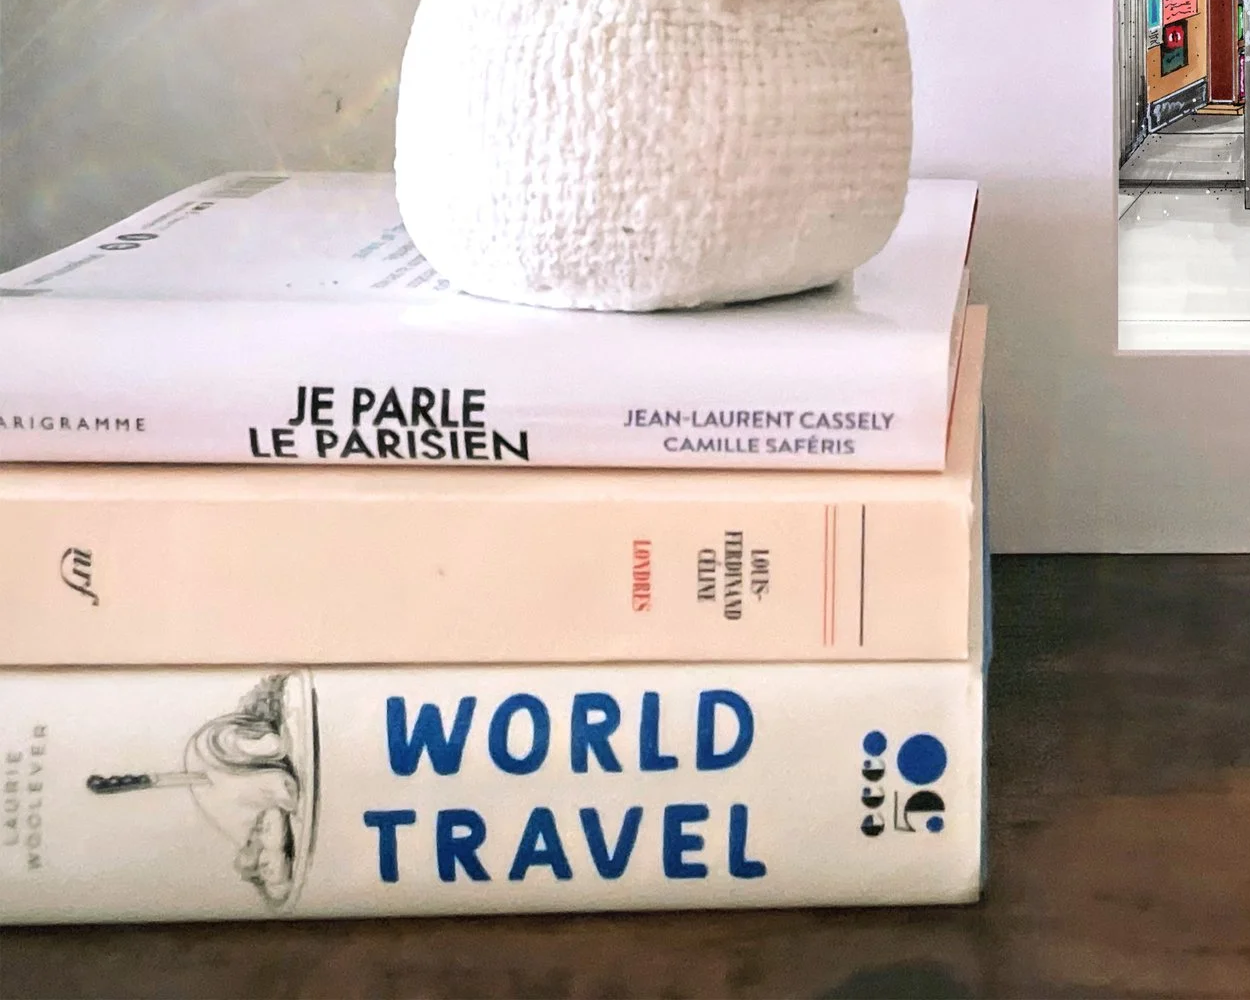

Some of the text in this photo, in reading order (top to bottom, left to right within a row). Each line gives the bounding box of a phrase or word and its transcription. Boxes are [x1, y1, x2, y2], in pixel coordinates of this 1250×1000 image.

[288, 386, 486, 428] JE PARLE
[623, 408, 895, 431] JEAN-LAURENT CASSELY
[249, 427, 530, 462] LE PARISIEN
[663, 434, 856, 455] CAMILLE SAFÉRIS
[632, 539, 652, 612] LONDRES
[696, 548, 721, 603] CÉLINE
[723, 530, 744, 621] FERDINAND
[750, 549, 770, 602] LOUIS-
[386, 690, 755, 777] WORLD
[2, 750, 24, 847] LAURIE
[25, 724, 48, 871] WOOLEVER
[363, 803, 768, 884] TRAVEL
